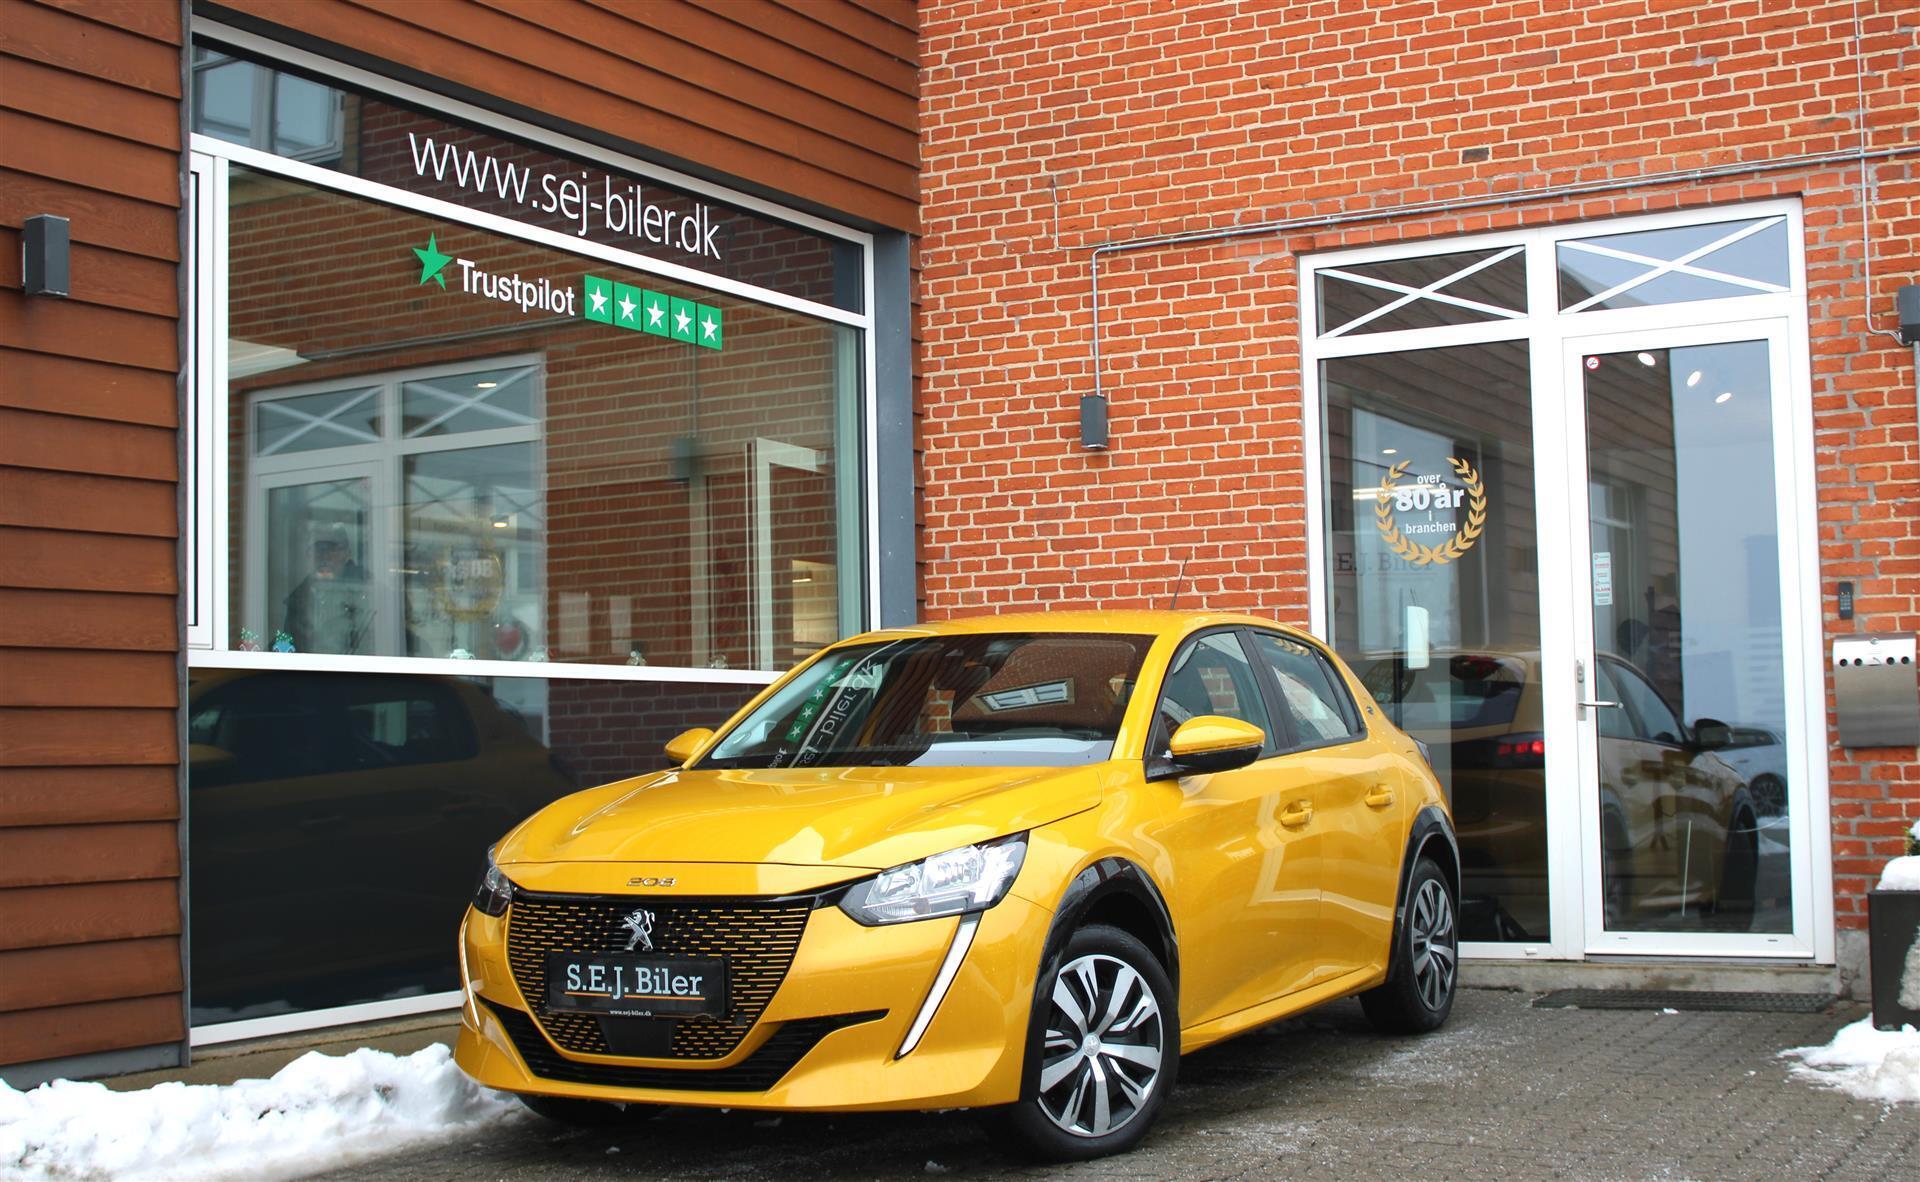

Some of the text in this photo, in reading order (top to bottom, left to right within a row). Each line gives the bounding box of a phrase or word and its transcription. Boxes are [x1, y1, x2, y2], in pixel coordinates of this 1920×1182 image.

[408, 132, 721, 260] www.sej-biler.dk
[457, 258, 575, 316] Trustpilot
[1417, 474, 1441, 484] over
[1395, 483, 1464, 511] 80 år
[1405, 521, 1456, 534] branchen
[626, 877, 676, 887] 208
[567, 964, 703, 1000] S.E.J. Biler
